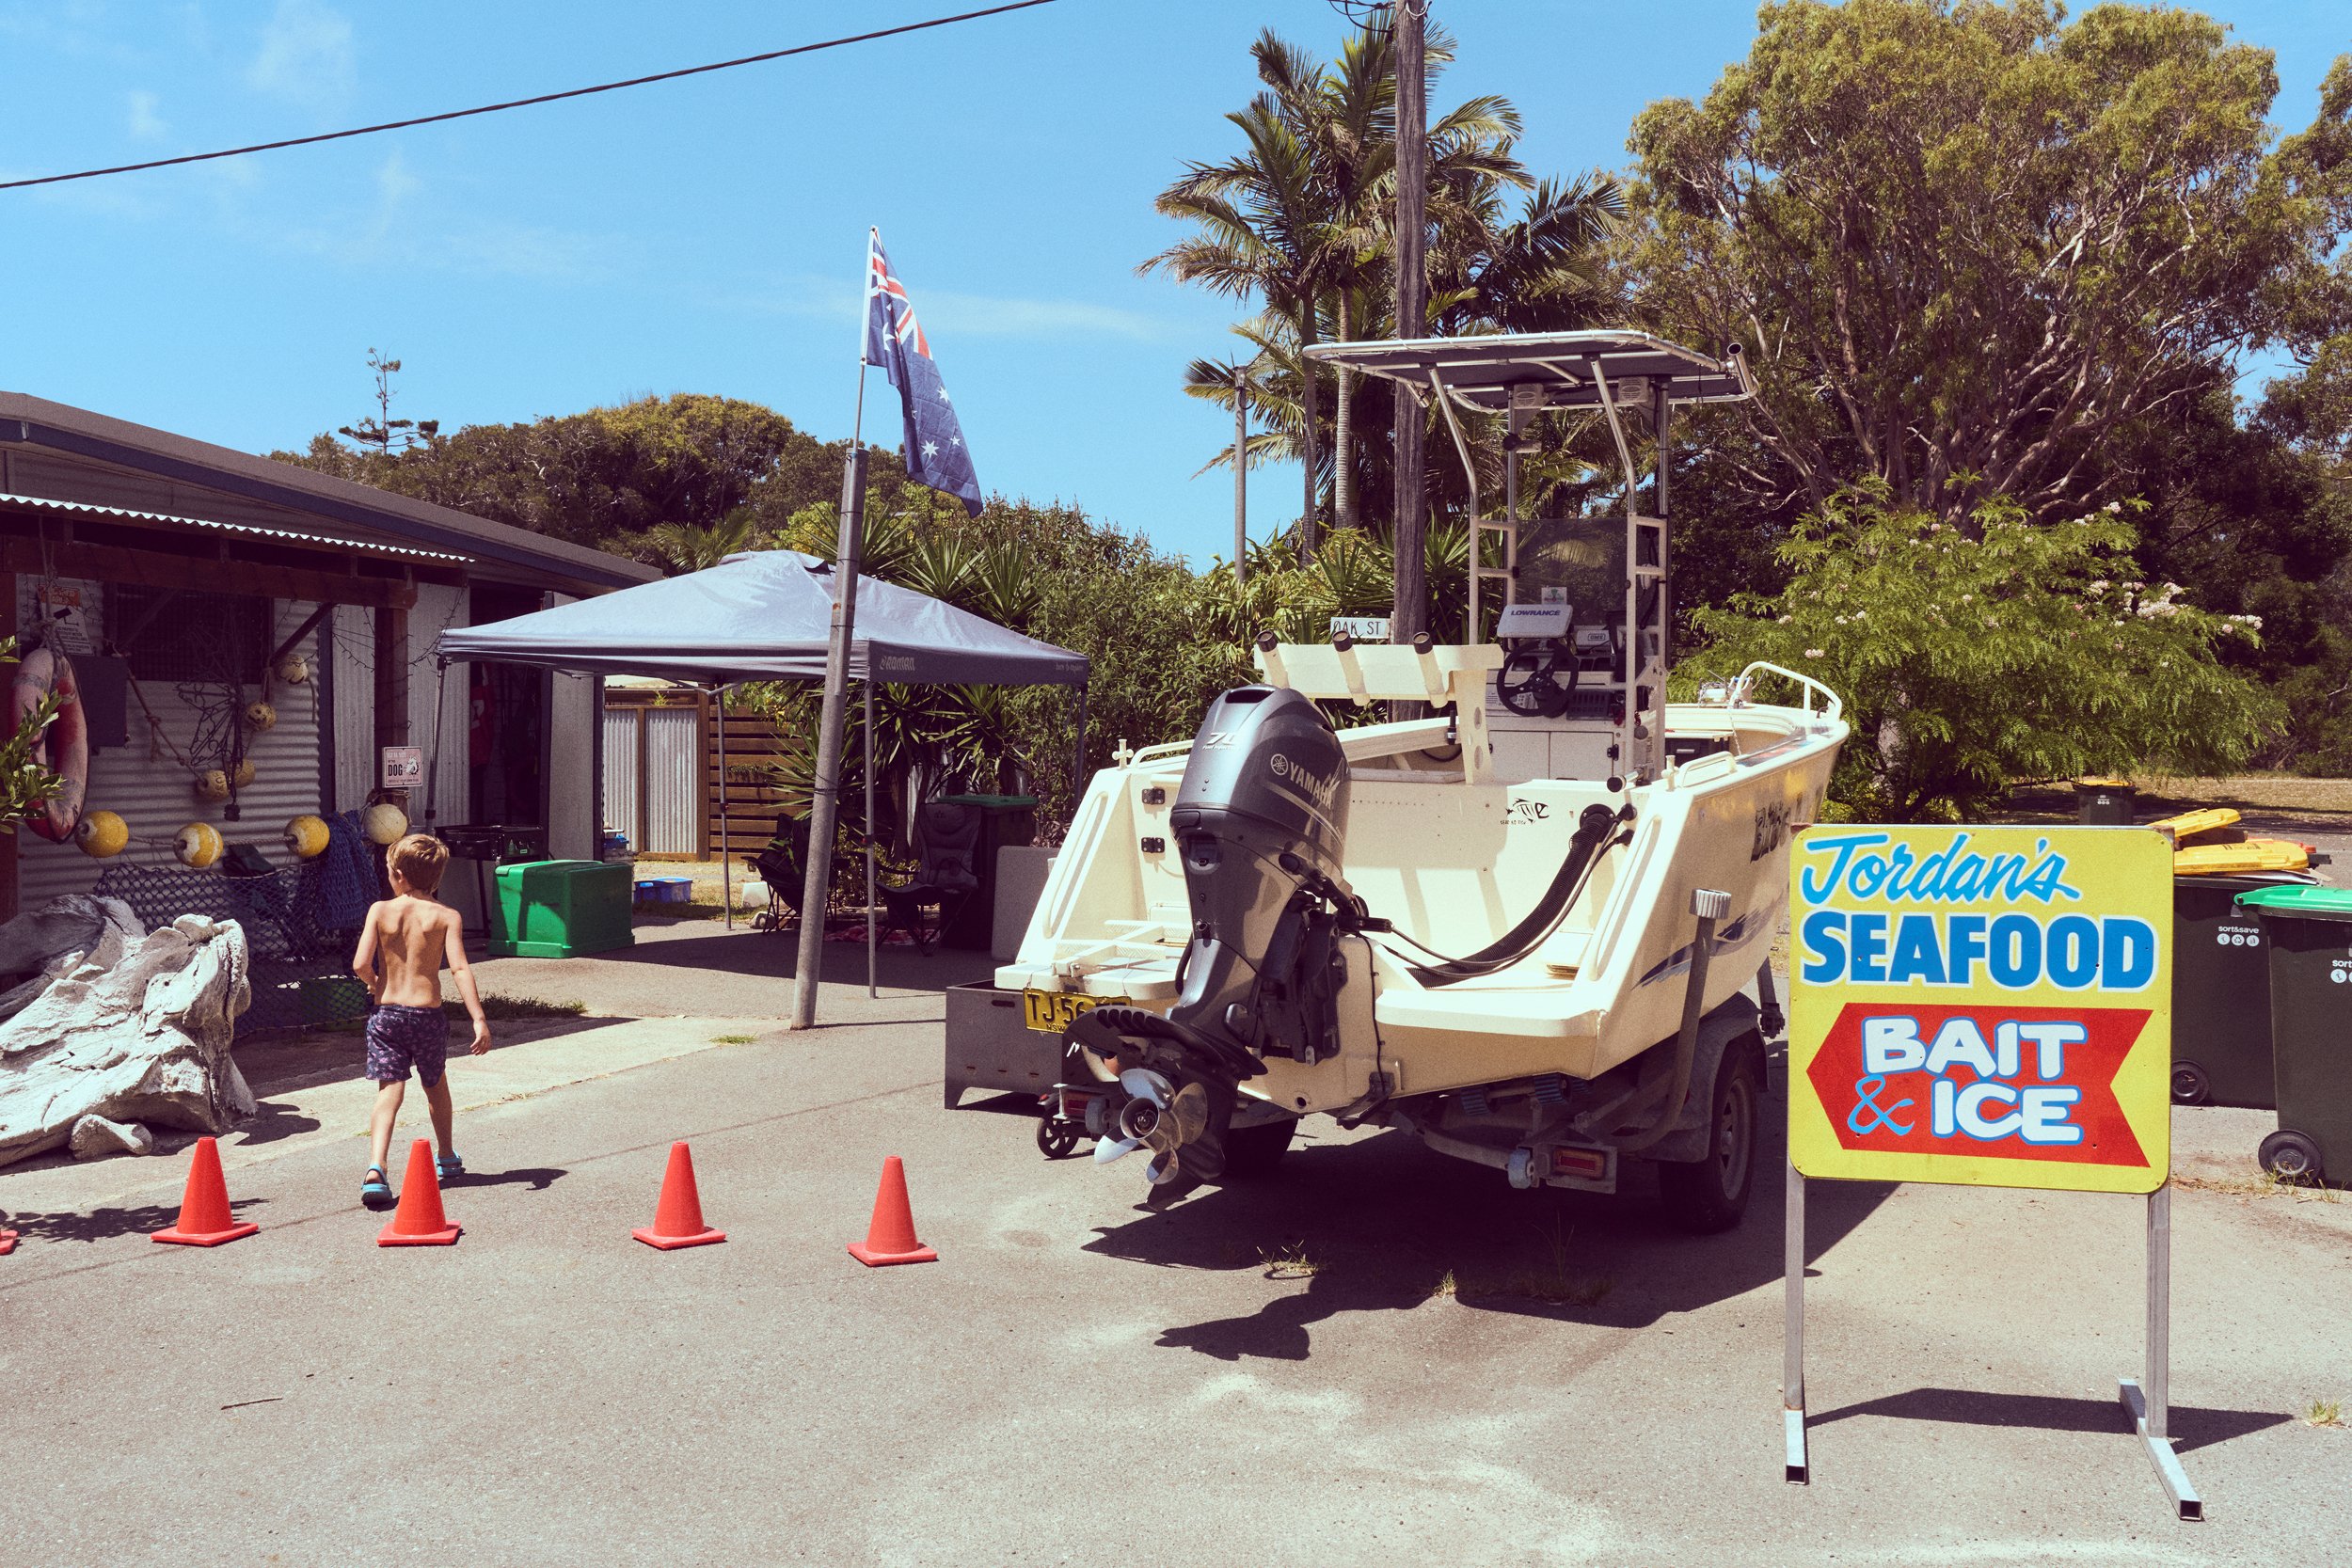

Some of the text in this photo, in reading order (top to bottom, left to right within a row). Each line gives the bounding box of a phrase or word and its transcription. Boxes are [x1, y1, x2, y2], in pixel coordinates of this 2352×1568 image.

[1334, 621, 1381, 635] OAK ST
[388, 764, 403, 776] DOG
[1290, 761, 1332, 810] YAMAHA
[1801, 832, 2082, 906] Jordan's
[1801, 908, 2157, 991] SEAFOOD
[2217, 926, 2260, 934] sort&save
[1045, 1023, 1066, 1033] NSW
[1862, 1015, 2088, 1081] BAIT
[1847, 1074, 2084, 1146] & ICE
